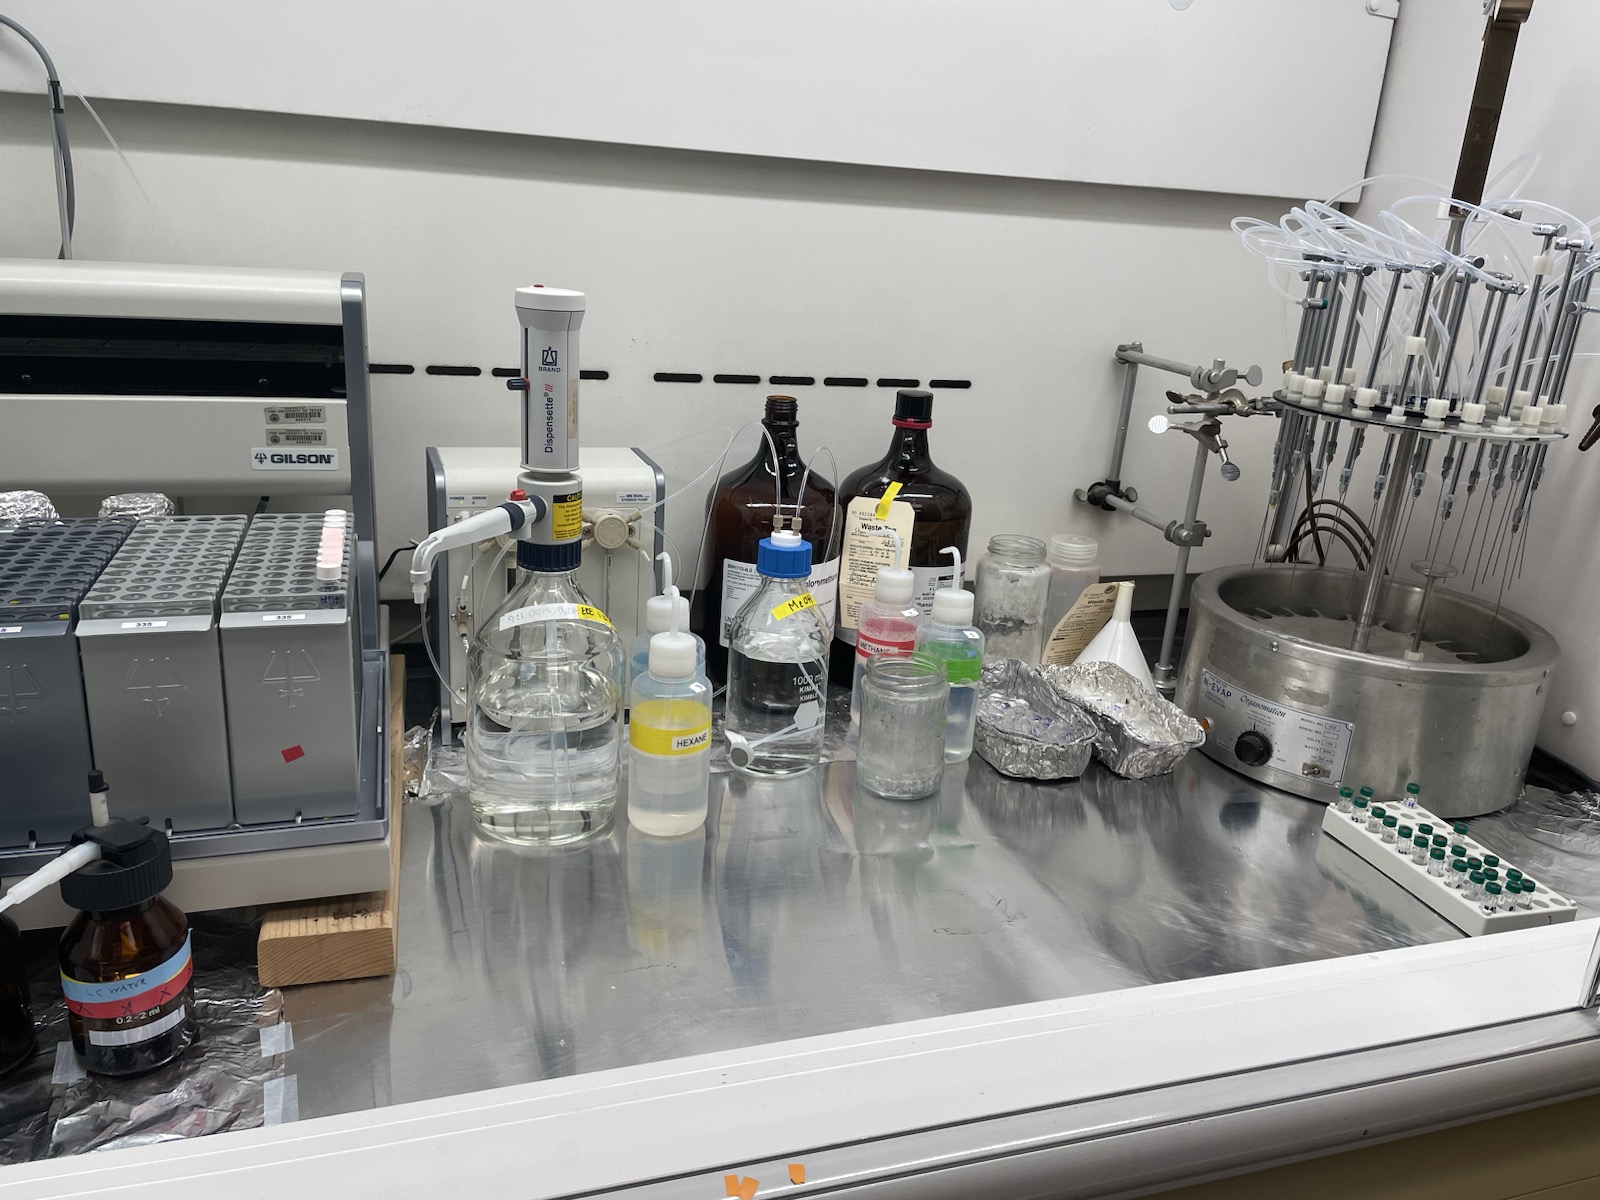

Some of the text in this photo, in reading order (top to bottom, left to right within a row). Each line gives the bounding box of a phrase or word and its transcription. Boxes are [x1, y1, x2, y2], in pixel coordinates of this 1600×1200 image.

[861, 522, 882, 531] Waste
[788, 594, 814, 612] MeOH
[1203, 676, 1233, 699] N-EVAP
[1240, 694, 1287, 718] Organomation
[676, 732, 708, 748] HEXANE
[109, 978, 148, 995] WATER
